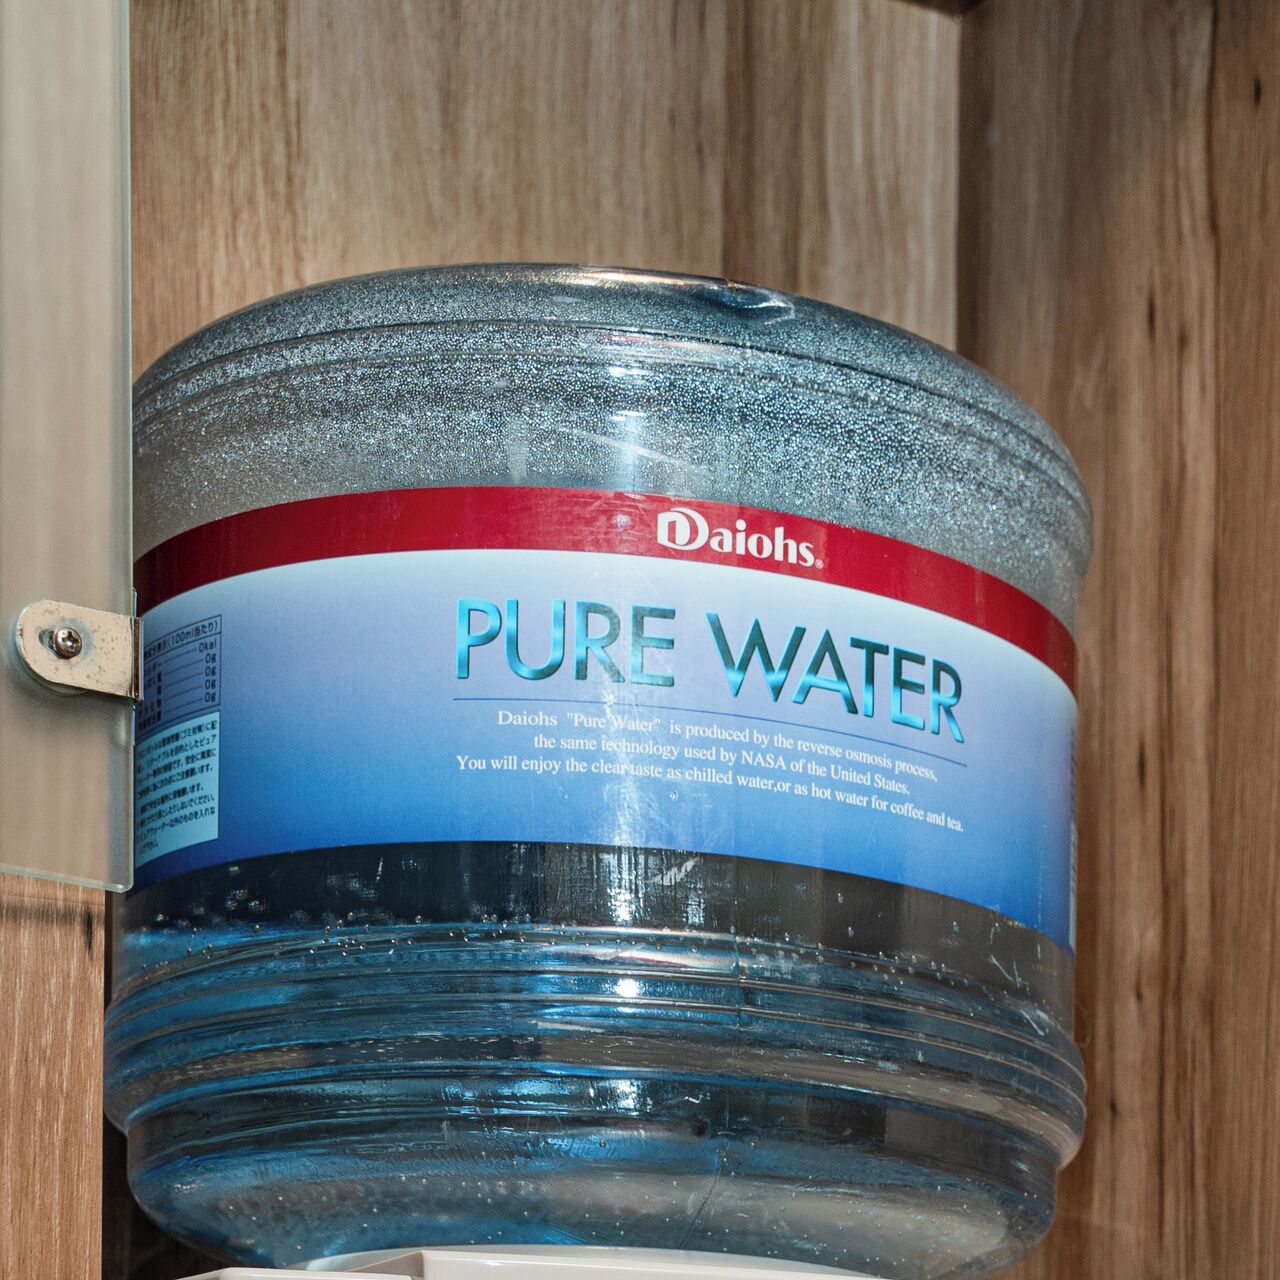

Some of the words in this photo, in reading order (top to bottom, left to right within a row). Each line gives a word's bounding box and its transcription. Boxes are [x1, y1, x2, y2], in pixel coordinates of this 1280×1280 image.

[657, 507, 815, 567] Daiohs
[455, 598, 677, 688] PURE
[705, 611, 966, 744] WATER
[498, 711, 558, 726] Daiohs
[567, 712, 606, 729] "Pure
[611, 714, 661, 732] Water"
[669, 720, 682, 734] is
[686, 724, 749, 743] produced
[753, 729, 770, 747] by
[774, 733, 794, 748] the
[797, 740, 843, 758] reverse
[845, 749, 893, 769] osmosis
[895, 760, 938, 782] process,
[534, 734, 556, 748] the
[560, 737, 597, 751] same
[601, 736, 679, 760] technology
[684, 746, 716, 761] used
[720, 748, 737, 765] by
[741, 751, 786, 770] NASA
[790, 758, 804, 772] of
[807, 762, 827, 776] the
[831, 764, 871, 786] United
[874, 775, 910, 795] States.
[456, 756, 486, 770] You
[490, 756, 518, 770] will
[521, 758, 561, 774] enjoy
[566, 758, 587, 772] the
[591, 758, 626, 775] clear
[631, 763, 663, 778] taste
[667, 767, 682, 779] as
[685, 767, 733, 785] chilled
[794, 785, 808, 796] as
[811, 781, 832, 800] hot
[835, 791, 868, 807] water
[871, 795, 888, 811] for
[890, 803, 924, 820] coffee
[926, 811, 945, 826] and
[946, 817, 964, 832] tea.
